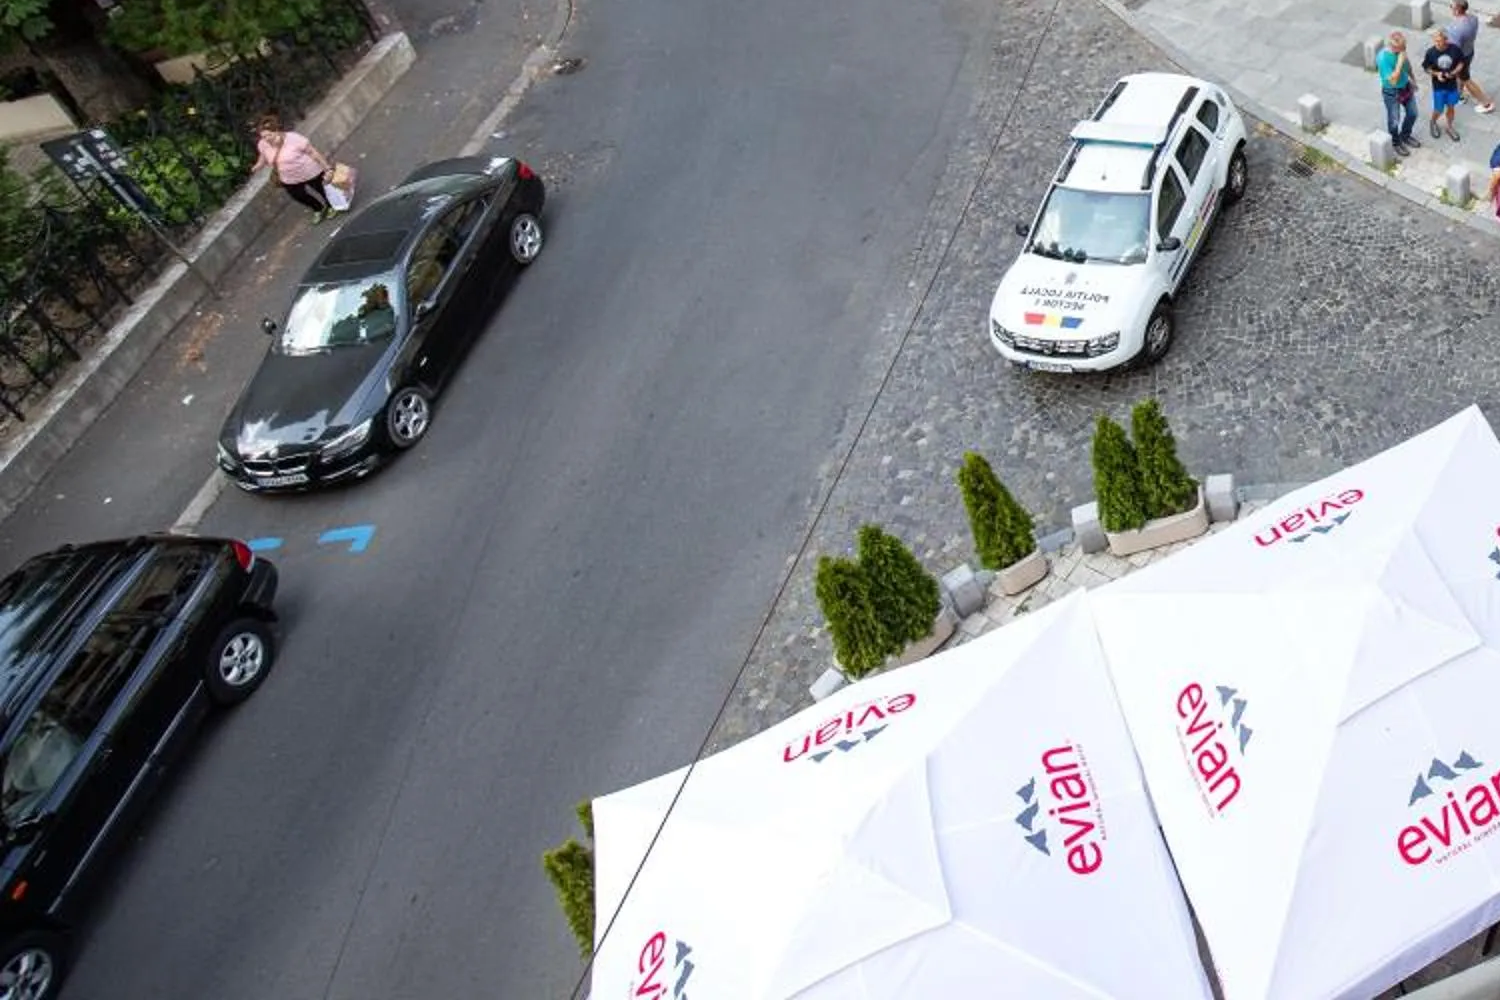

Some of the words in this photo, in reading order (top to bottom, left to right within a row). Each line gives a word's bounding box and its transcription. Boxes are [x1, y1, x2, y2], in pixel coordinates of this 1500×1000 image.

[1255, 488, 1365, 547] evian
[783, 692, 917, 763] evian
[1176, 682, 1242, 811] evian
[1041, 745, 1103, 876] evian
